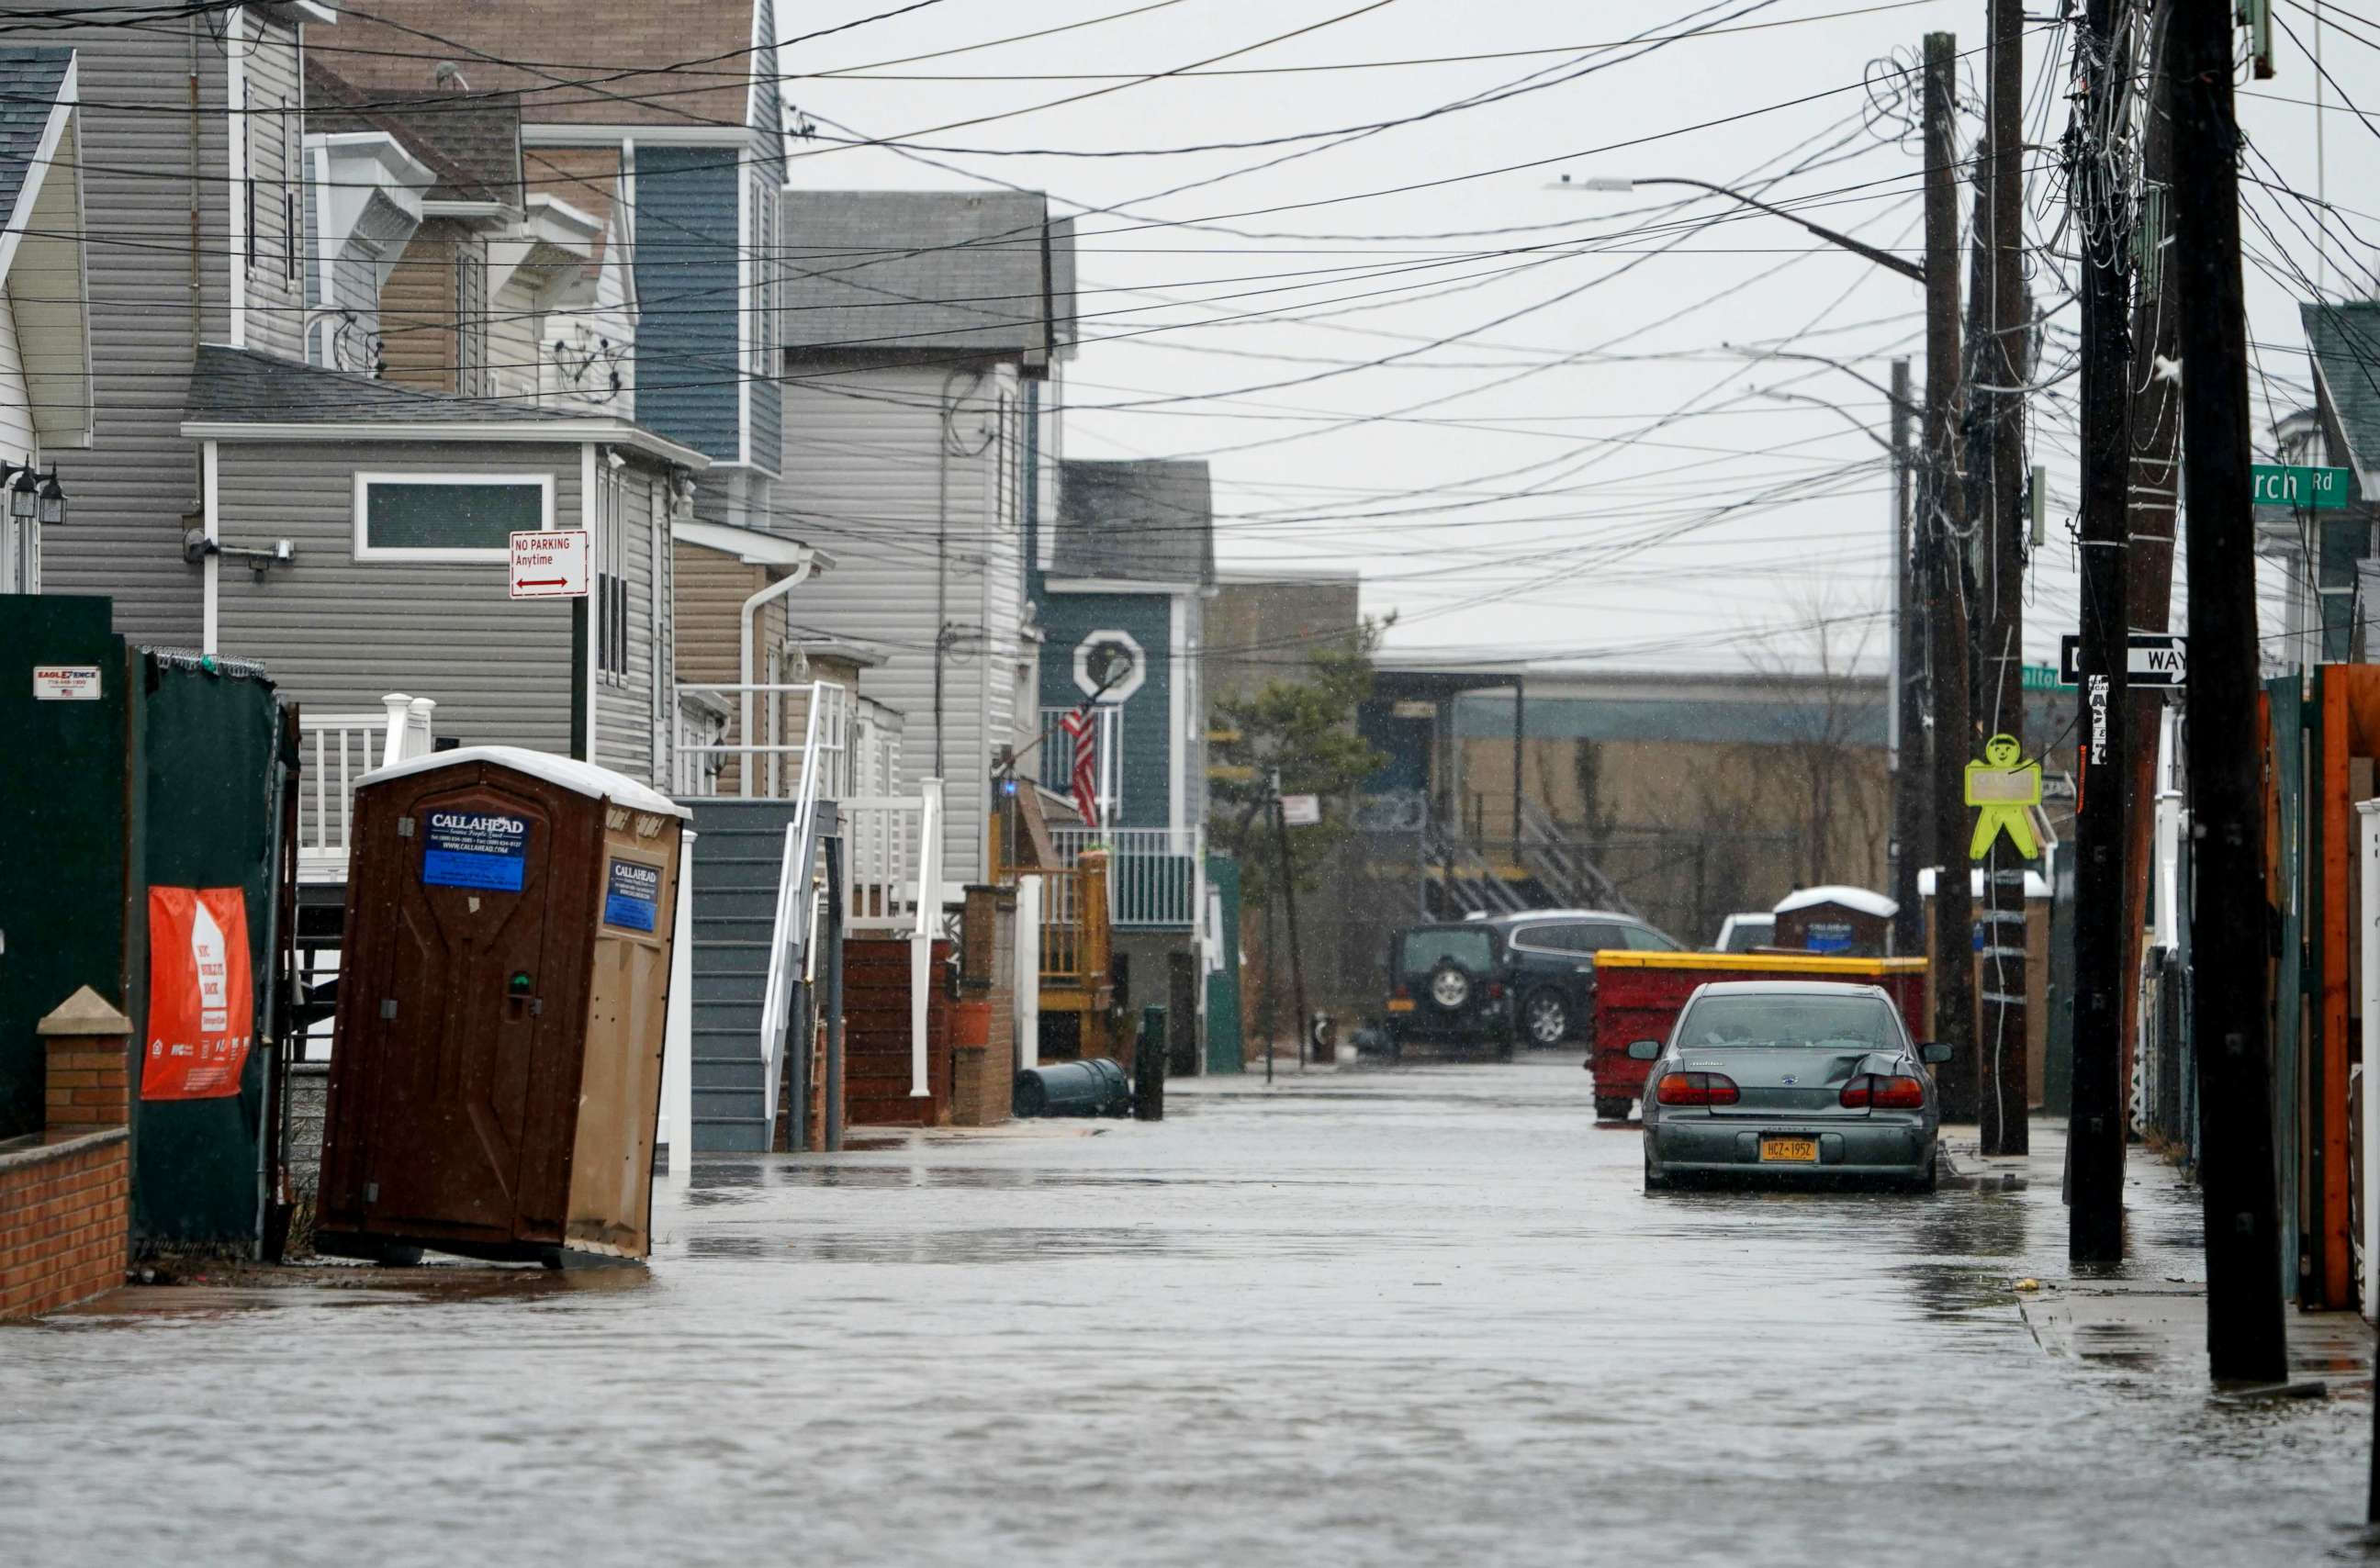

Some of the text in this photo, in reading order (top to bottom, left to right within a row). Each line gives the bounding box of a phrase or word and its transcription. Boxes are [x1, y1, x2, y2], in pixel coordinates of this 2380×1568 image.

[2254, 469, 2333, 499] rch Rd
[515, 538, 569, 551] NO PARKING
[515, 554, 553, 567] Anytime
[432, 813, 523, 834] CALLAHEAD
[615, 864, 657, 883] CALLAHEAD
[1768, 1142, 1811, 1157] HCZ 1952
